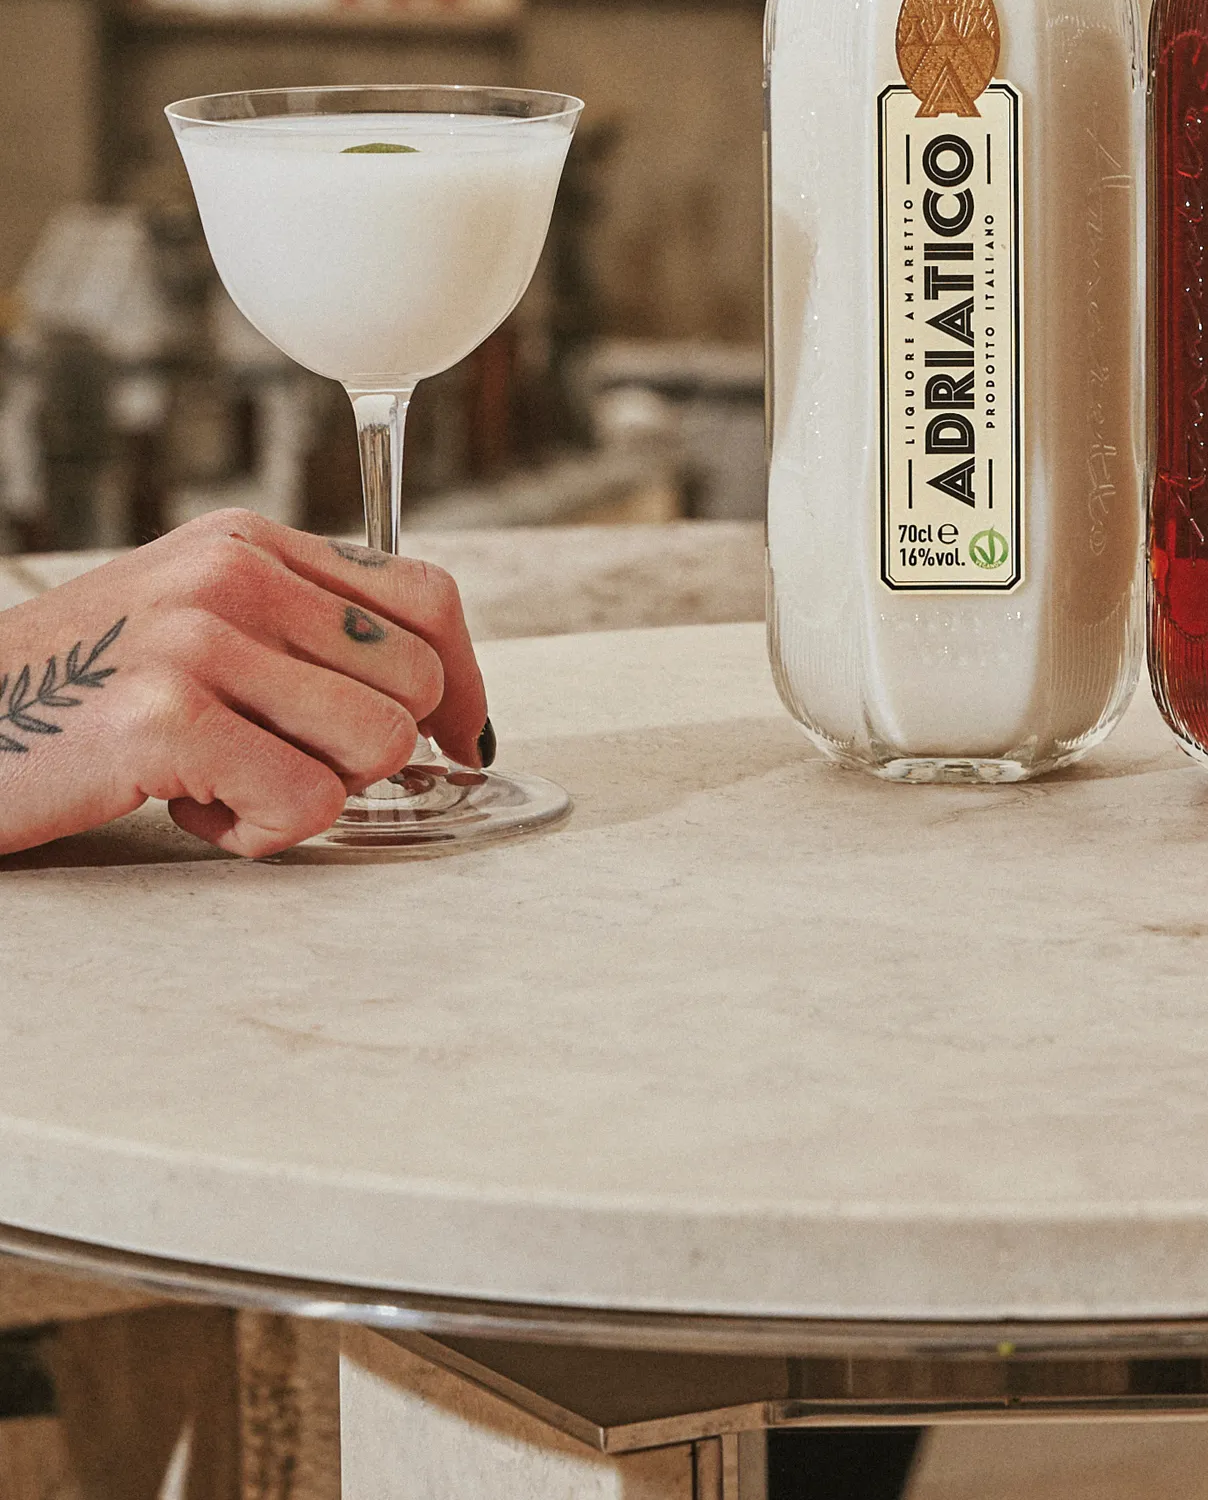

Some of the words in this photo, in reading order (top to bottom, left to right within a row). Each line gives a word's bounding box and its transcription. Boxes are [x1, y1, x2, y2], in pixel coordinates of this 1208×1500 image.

[903, 200, 915, 320] AMARETTO
[984, 215, 995, 310] ITALIANO
[922, 134, 976, 509] ADRIATICO
[904, 338, 915, 445] LIQUORE
[985, 327, 996, 429] PRODOTTO
[898, 524, 933, 544] 70cl
[899, 547, 966, 567] 16%vol.
